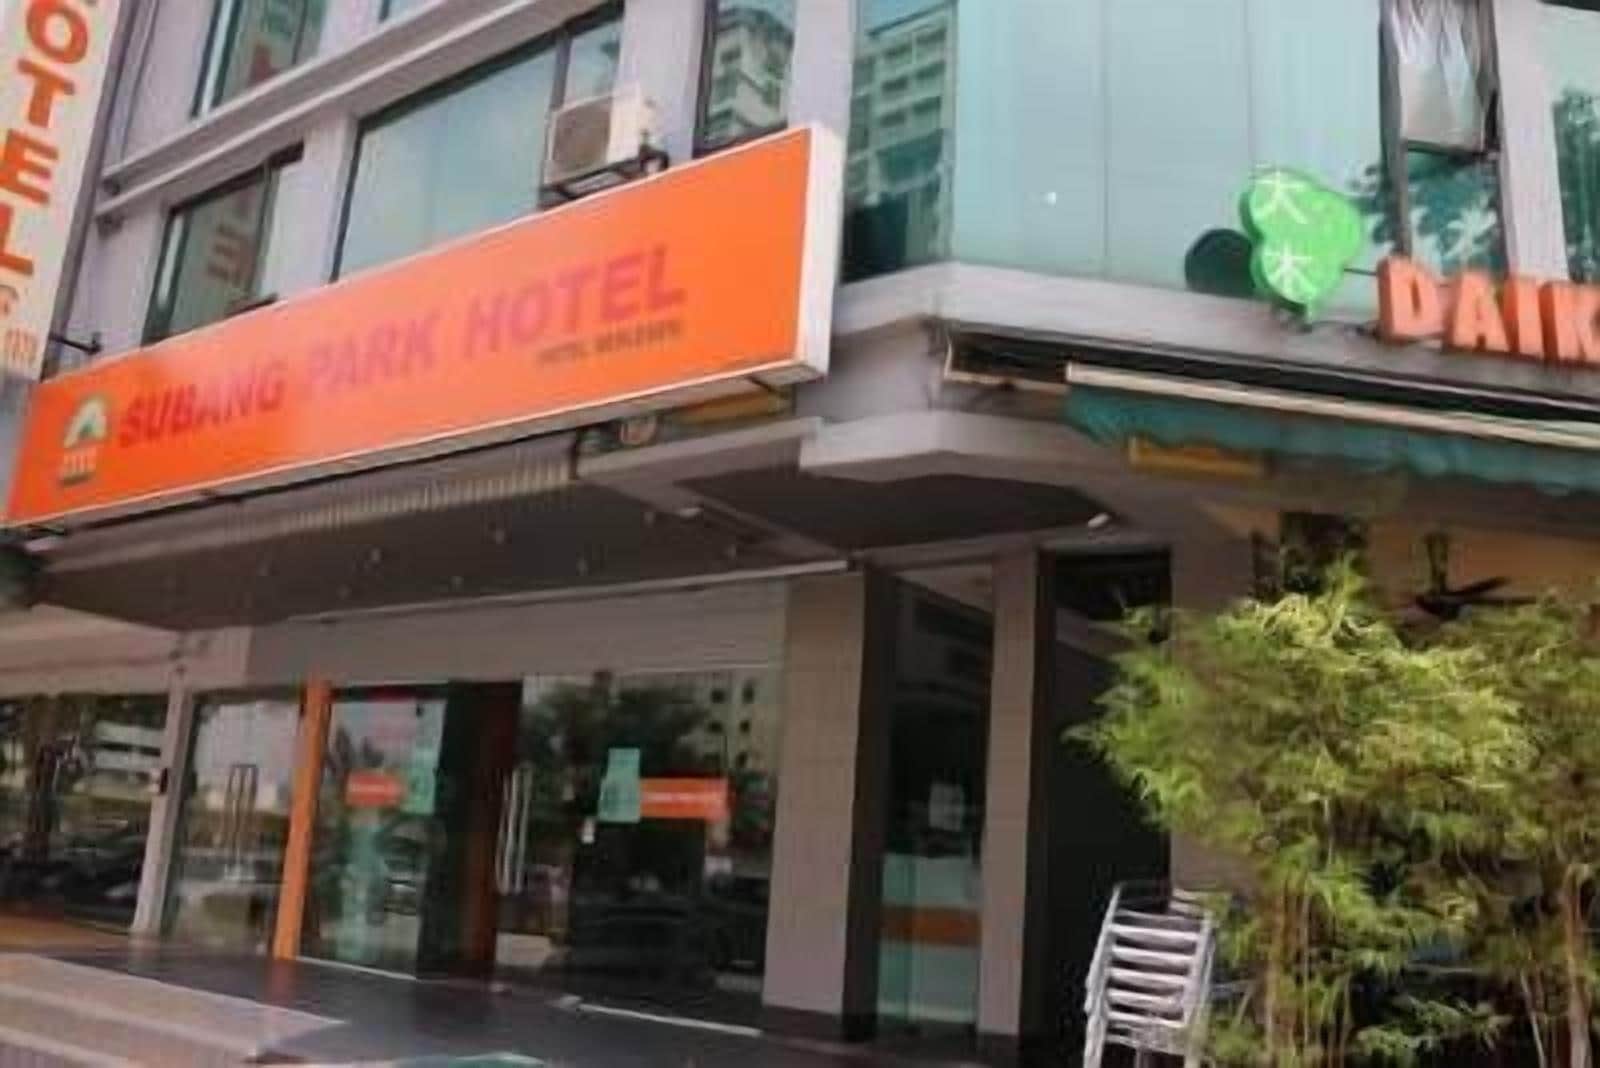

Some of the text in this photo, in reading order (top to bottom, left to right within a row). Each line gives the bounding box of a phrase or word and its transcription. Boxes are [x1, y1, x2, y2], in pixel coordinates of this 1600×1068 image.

[0, 0, 90, 277] OTEL
[118, 358, 287, 449] SUBANG
[307, 306, 441, 393] PARK
[463, 242, 687, 361] HOTEL
